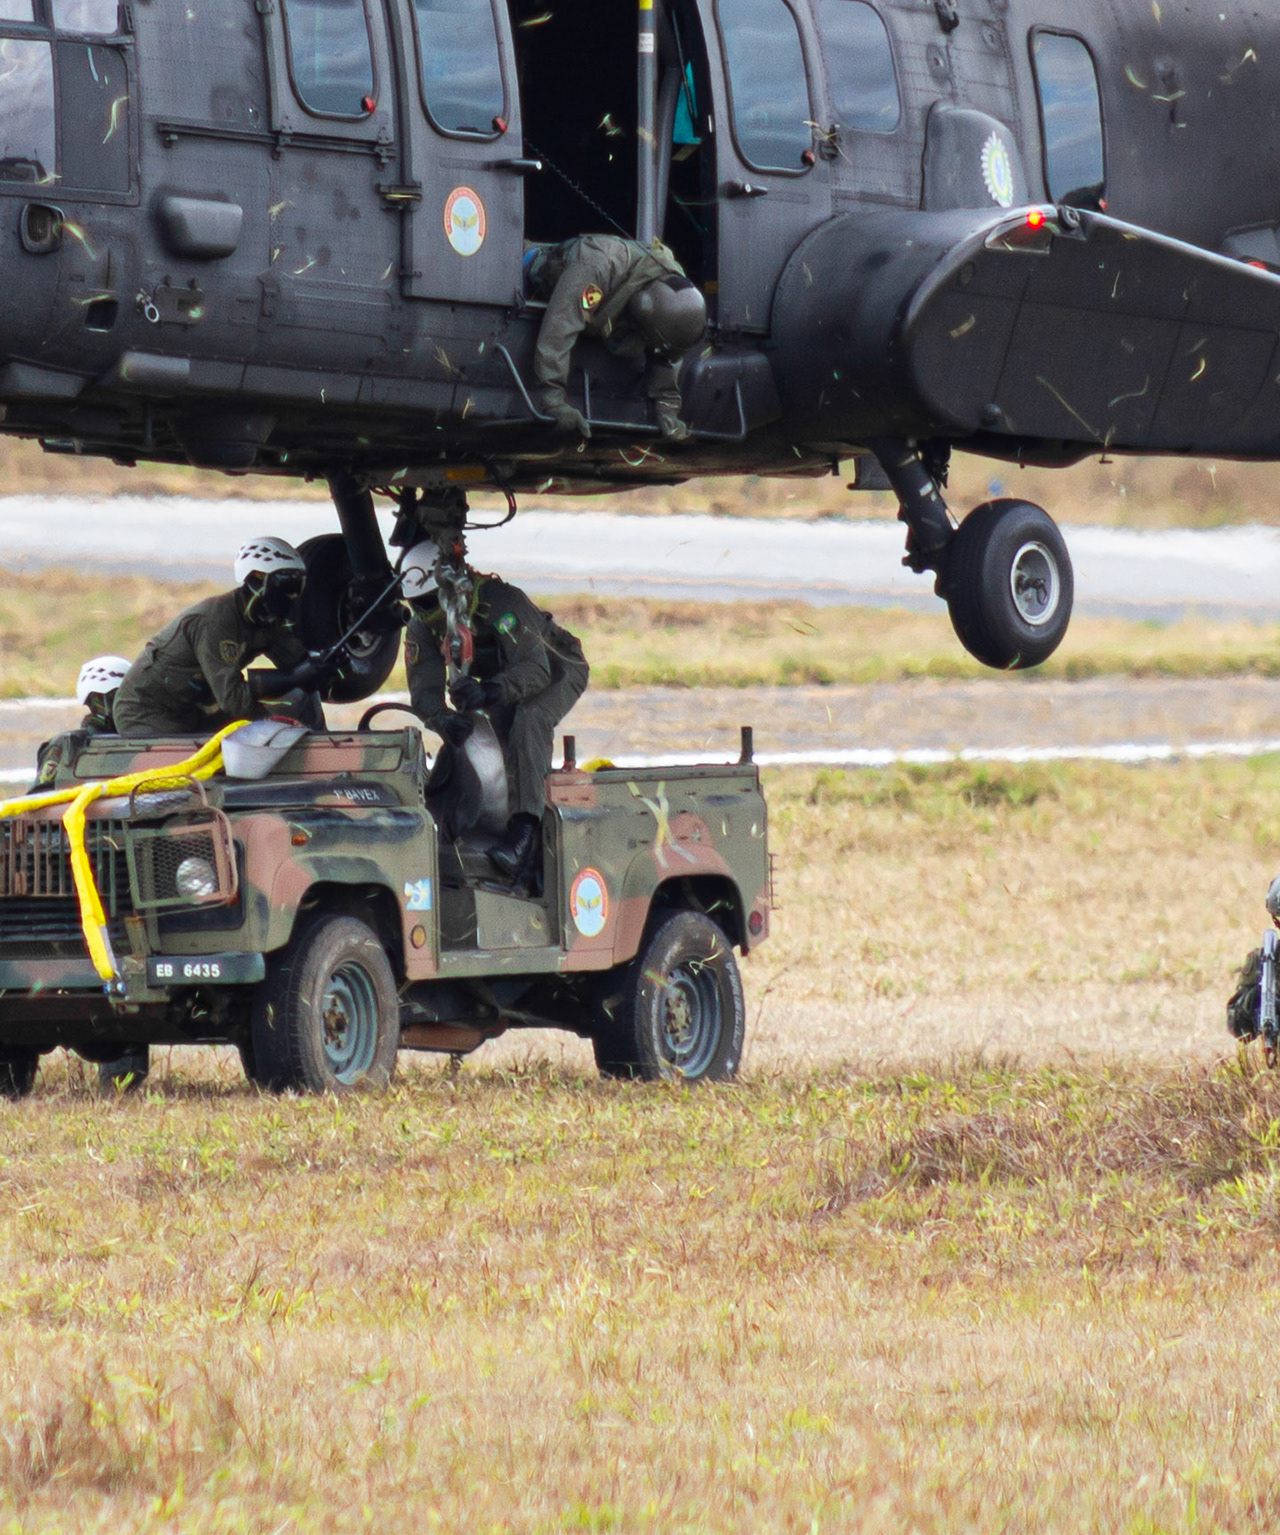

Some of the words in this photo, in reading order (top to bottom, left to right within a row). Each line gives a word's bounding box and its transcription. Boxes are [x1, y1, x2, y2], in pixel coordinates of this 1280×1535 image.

[344, 789, 380, 801] BAVEX
[156, 964, 173, 977] EB
[183, 964, 220, 977] 6435
